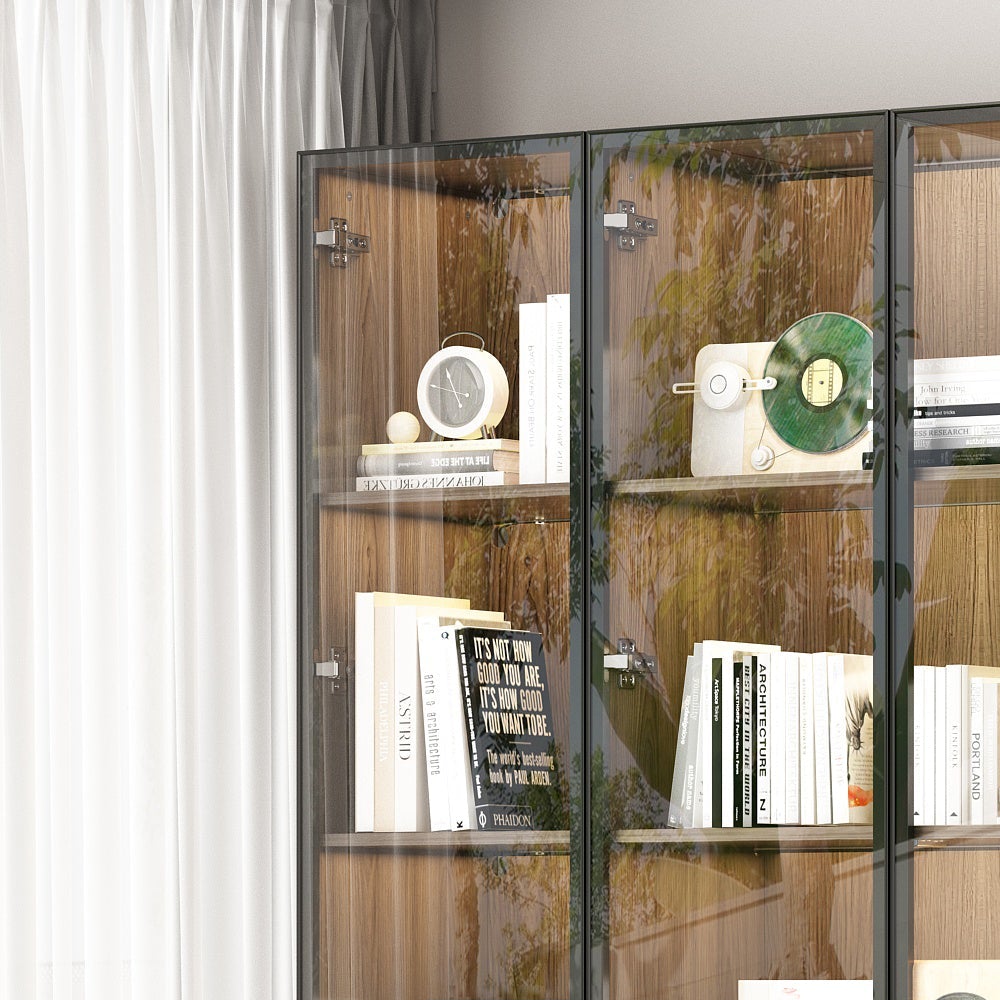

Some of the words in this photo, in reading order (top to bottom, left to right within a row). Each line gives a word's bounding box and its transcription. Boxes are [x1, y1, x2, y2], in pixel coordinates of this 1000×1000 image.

[920, 384, 938, 396] John
[928, 427, 969, 436] RESEARCH
[474, 637, 491, 660] IT'S
[492, 638, 510, 662] NOT
[512, 640, 532, 663] HOW
[424, 674, 434, 694] arts
[477, 662, 500, 685] GOOD
[503, 664, 521, 686] YOU
[524, 665, 544, 691] ARE,
[480, 687, 498, 710] IT'S
[498, 687, 518, 711] HOW
[520, 689, 543, 712] GOOD
[398, 692, 411, 761] ASTRID
[482, 711, 500, 734] YOU
[500, 712, 525, 735] WANT
[759, 664, 767, 777] ARCHITECTURE
[427, 712, 440, 775] architecture
[744, 730, 750, 742] IN
[486, 749, 498, 765] The
[499, 750, 521, 766] world's
[521, 751, 554, 771] best-selling
[972, 733, 980, 801] PORTLAND
[489, 768, 504, 784] book
[505, 769, 513, 787] by
[513, 769, 530, 785] PAUL
[530, 770, 552, 786] ARDEN.
[493, 813, 531, 827] PHAIDON
